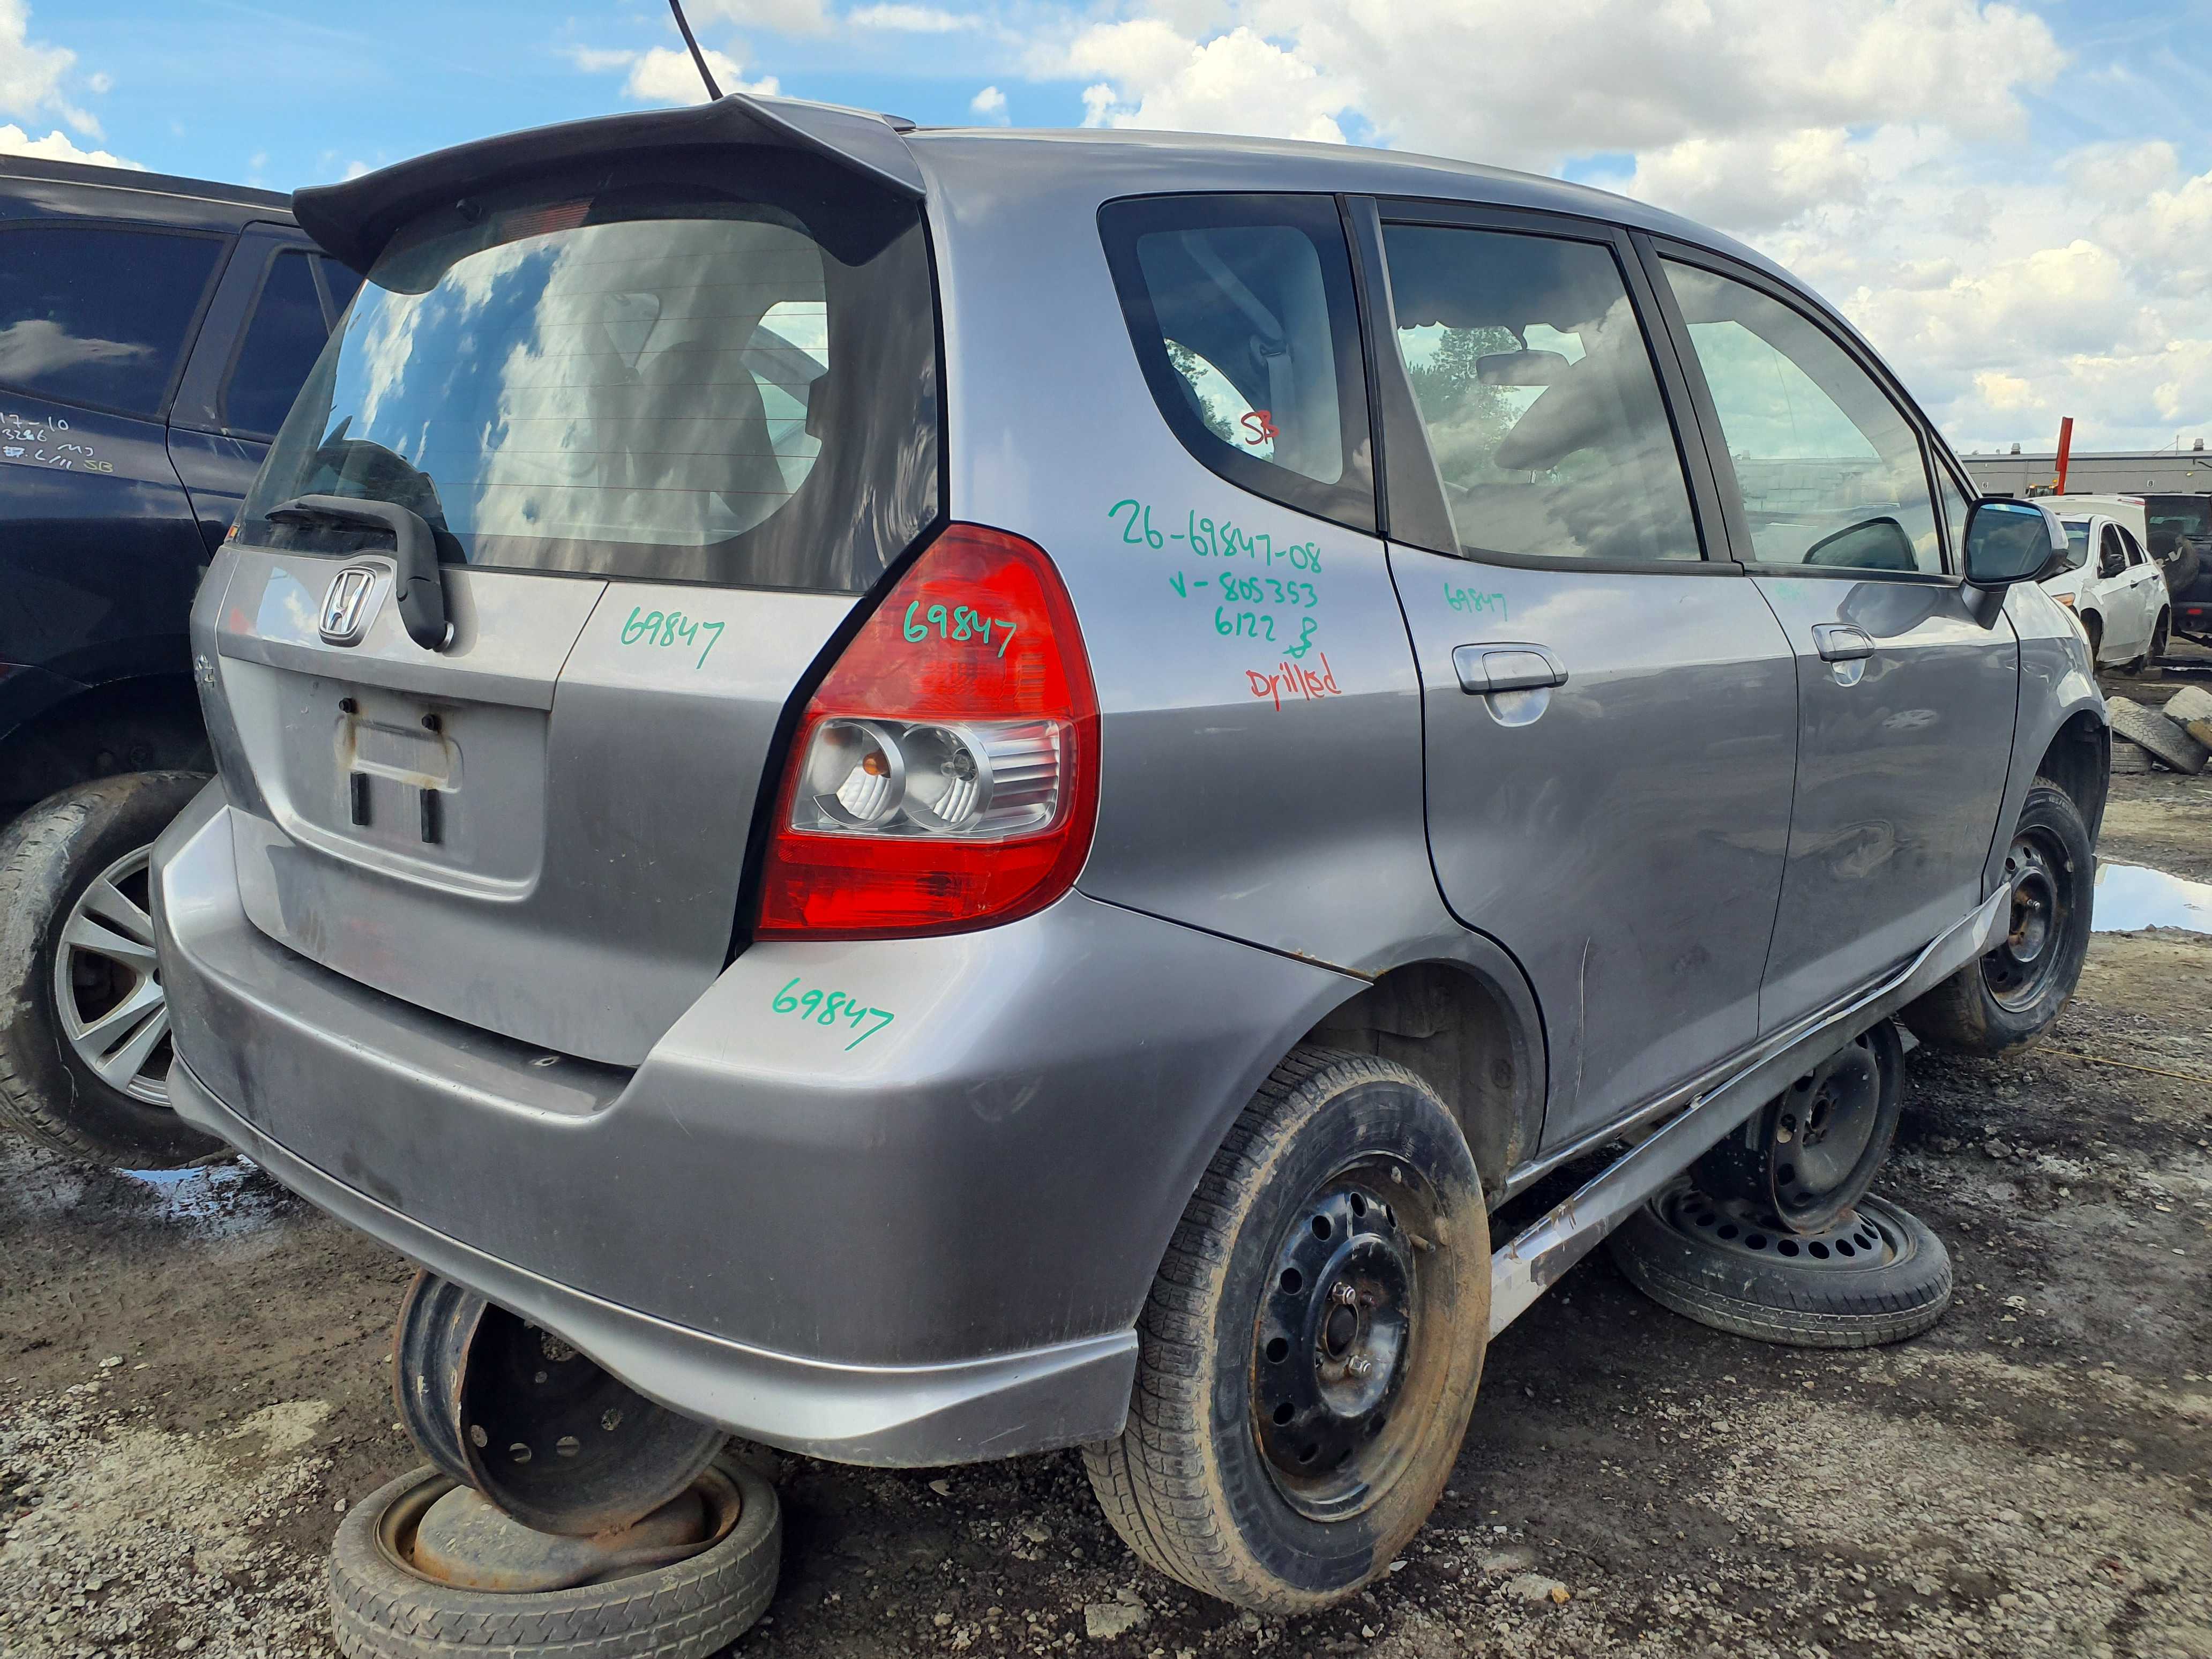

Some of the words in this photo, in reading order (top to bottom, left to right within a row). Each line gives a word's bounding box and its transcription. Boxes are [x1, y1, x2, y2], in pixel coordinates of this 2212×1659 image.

[1108, 499, 1322, 573] 26-69847-08
[903, 600, 1017, 658] 69847
[1444, 582, 1508, 622] 69847
[621, 607, 726, 669] 69847
[772, 977, 895, 1051] 69847
